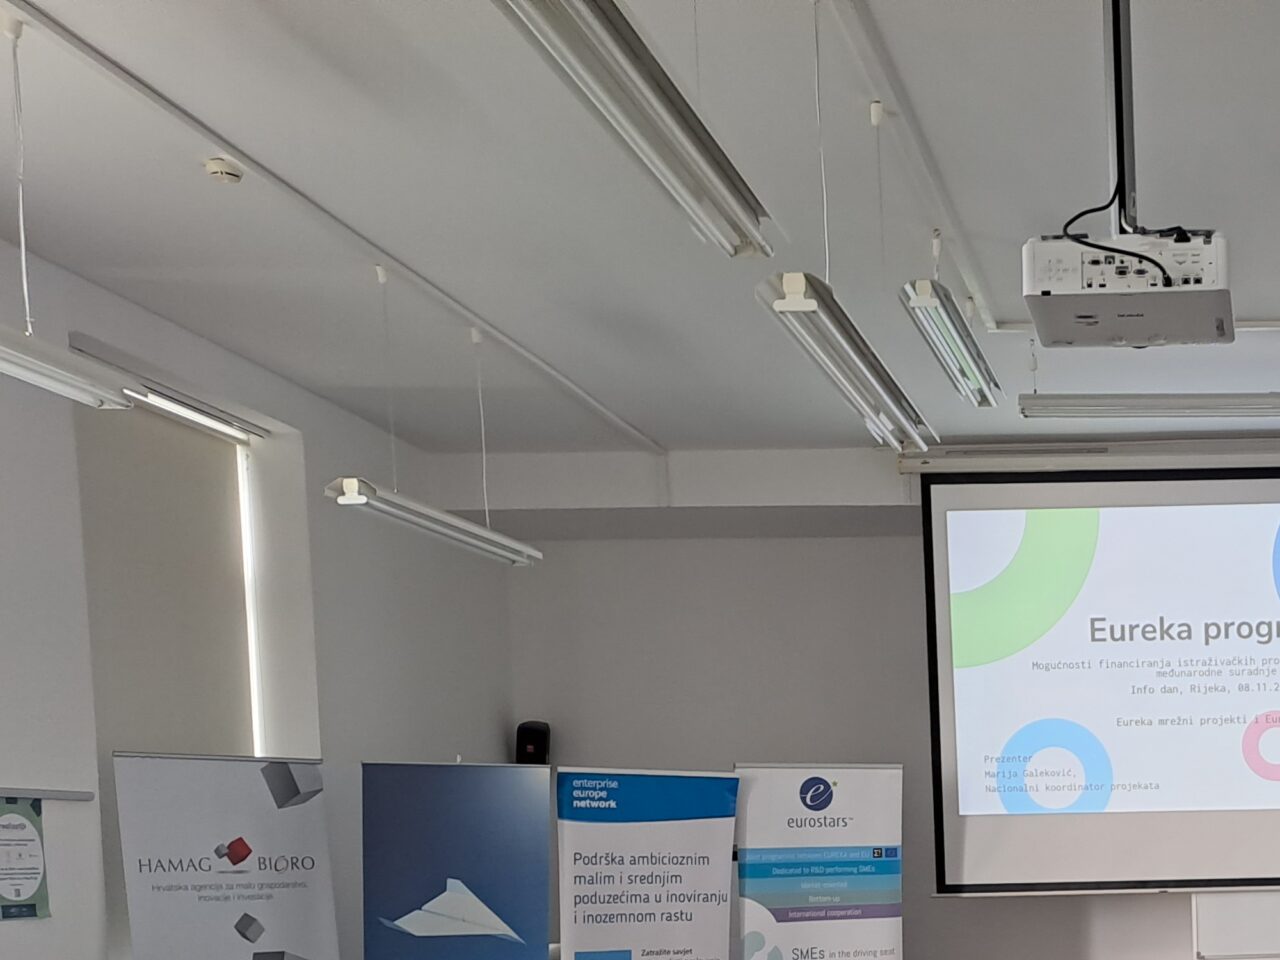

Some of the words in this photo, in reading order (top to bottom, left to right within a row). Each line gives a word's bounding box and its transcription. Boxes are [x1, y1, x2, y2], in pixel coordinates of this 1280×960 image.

[1089, 616, 1193, 643] Eureka
[1031, 659, 1092, 672] Mogućnosti
[1099, 657, 1171, 669] financiranja
[1177, 655, 1256, 668] istraživačkih
[1155, 667, 1223, 678] međunarodne
[1228, 666, 1278, 678] suradnje
[1130, 684, 1155, 695] Info
[1160, 684, 1183, 696] dan,
[1190, 683, 1231, 695] Rijeka,
[1116, 717, 1153, 727] Eureka
[1158, 716, 1194, 726] mrežni
[1200, 714, 1248, 727] projekti
[984, 754, 1032, 764] Prezenter
[984, 769, 1018, 780] Marija
[572, 778, 619, 790] enterprise
[985, 783, 1040, 794] Nacionalni
[1045, 782, 1105, 792] koordinator
[1110, 780, 1161, 792] projekata
[572, 789, 608, 800] europe
[572, 799, 617, 808] network
[138, 857, 212, 873] HAMAG
[573, 852, 625, 866] Podrška
[629, 852, 710, 866] ambicioznim
[573, 871, 615, 886] malim
[627, 871, 682, 888] srednjim
[573, 890, 650, 908] poduzećima
[654, 892, 662, 903] u
[666, 889, 729, 906] inoviranju
[582, 911, 656, 924] inozemnom
[660, 910, 693, 922] rastu
[791, 946, 825, 960] SMEs
[828, 951, 837, 959] in
[838, 950, 851, 958] the
[852, 948, 878, 959] driving
